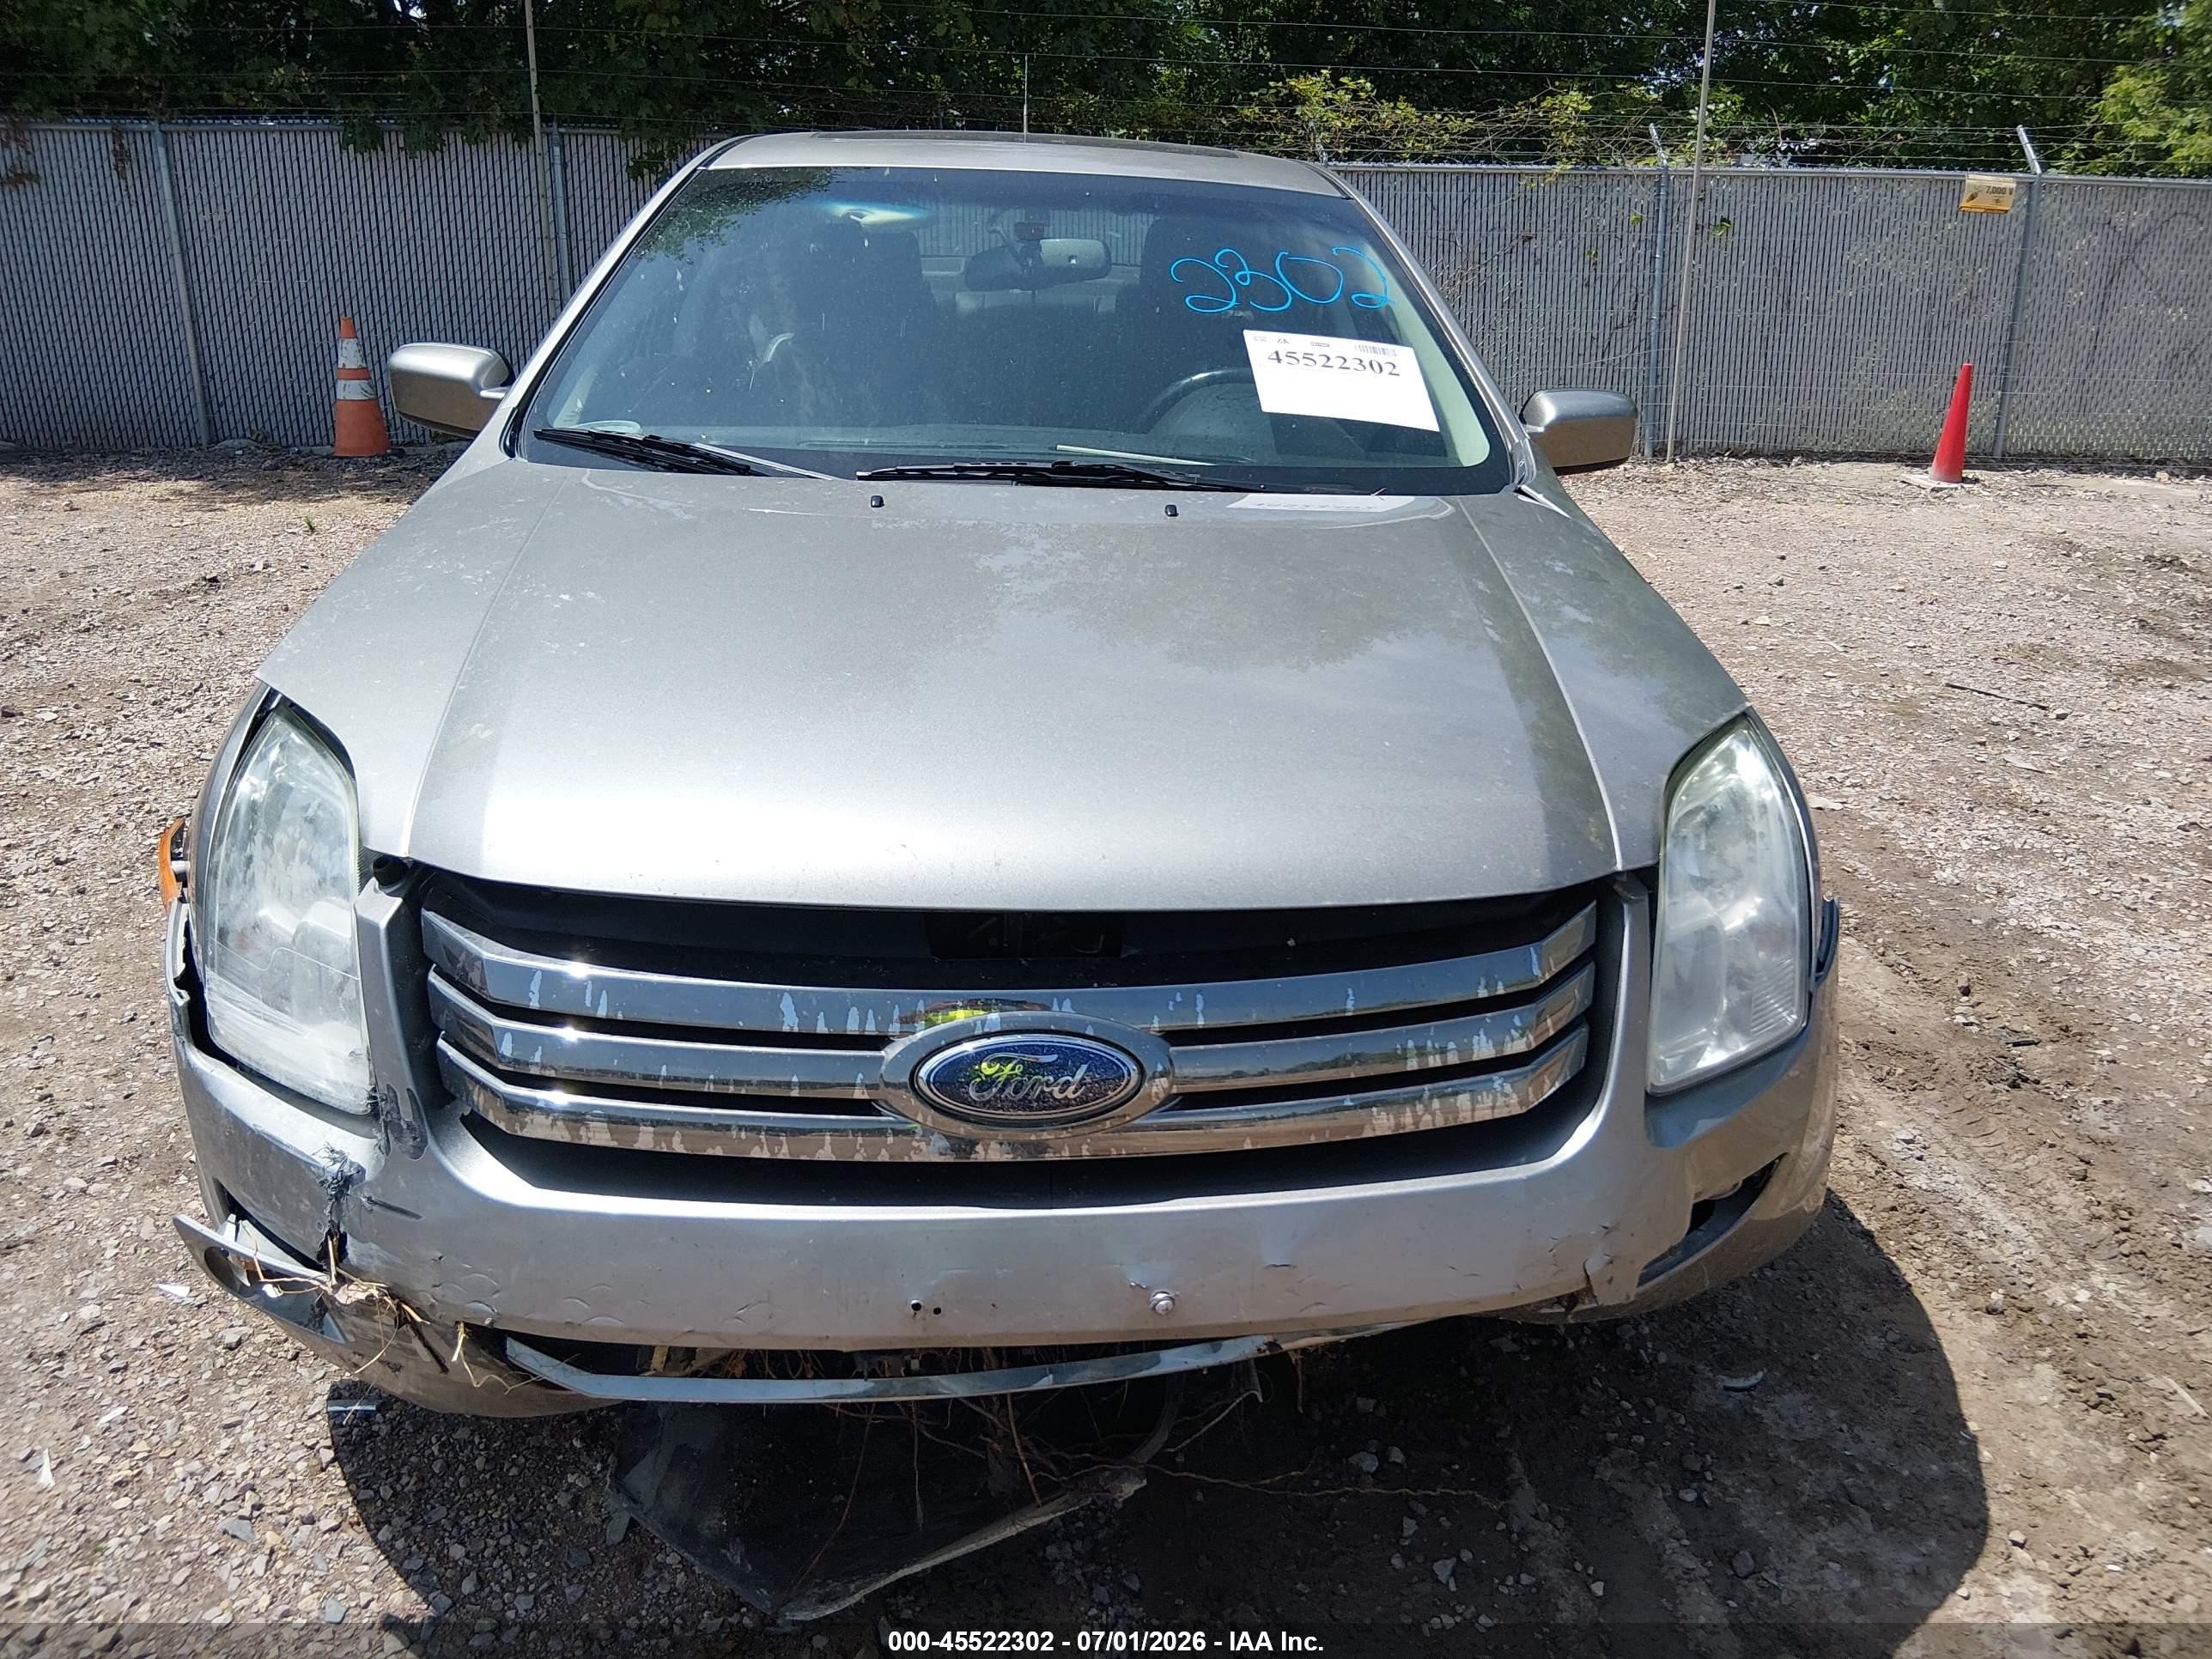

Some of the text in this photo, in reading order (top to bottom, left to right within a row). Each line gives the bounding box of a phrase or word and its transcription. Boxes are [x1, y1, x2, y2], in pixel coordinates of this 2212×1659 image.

[1985, 185, 2007, 196] 7,000
[1170, 247, 1396, 313] 2302
[1267, 350, 1400, 376] 45522302
[968, 1052, 1090, 1102] Ford
